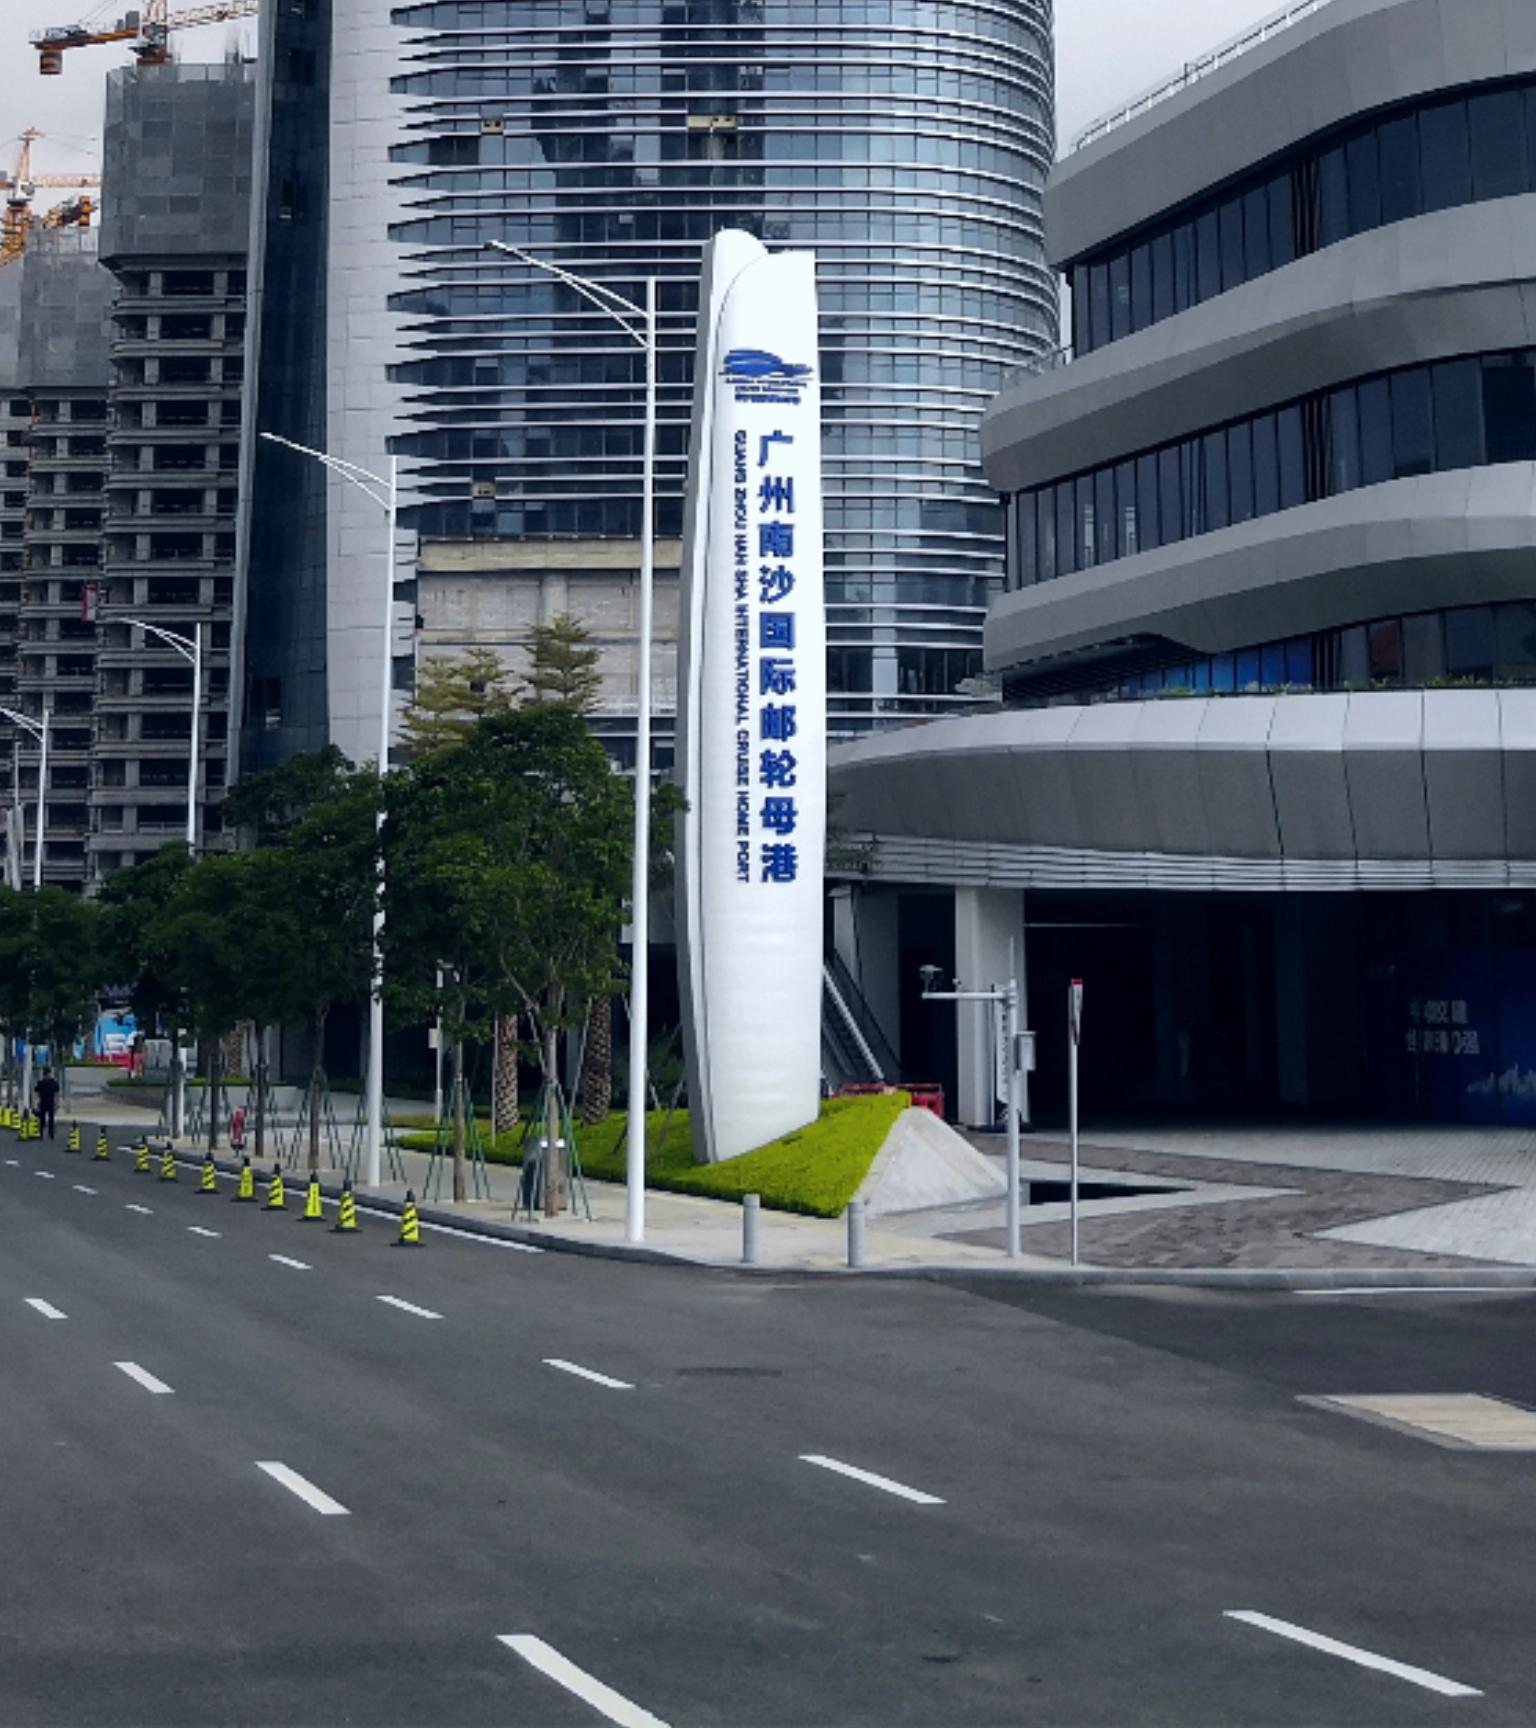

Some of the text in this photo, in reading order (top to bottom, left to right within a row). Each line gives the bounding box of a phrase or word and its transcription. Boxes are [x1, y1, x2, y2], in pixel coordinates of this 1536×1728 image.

[734, 430, 750, 883] GUANG ZHOU NAN SHA INTERNATIONAL CRUISE HOME PORT
[757, 429, 798, 883] 广州南沙国际邮轮母港
